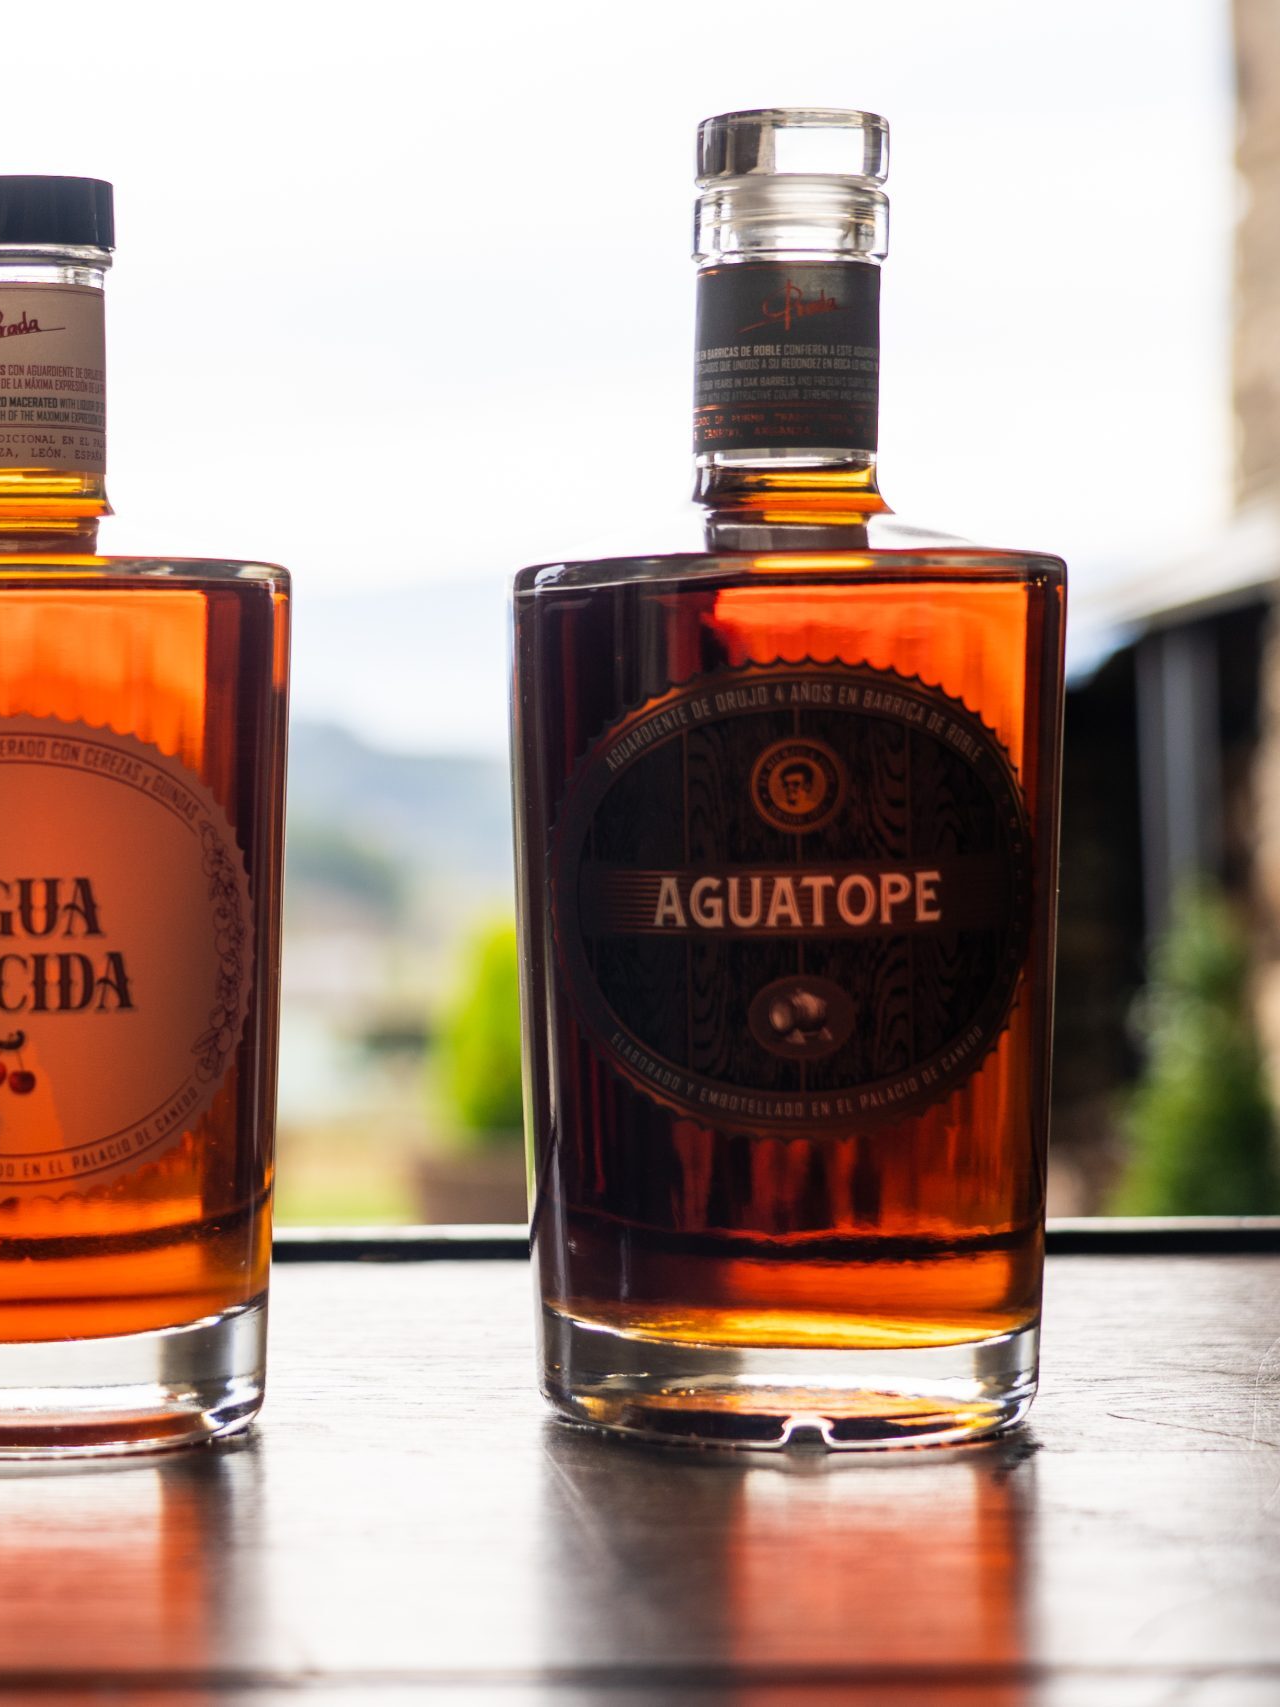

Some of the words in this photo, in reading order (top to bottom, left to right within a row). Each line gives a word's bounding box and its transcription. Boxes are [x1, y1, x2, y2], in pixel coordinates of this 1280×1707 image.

[740, 346, 753, 357] DE
[753, 344, 781, 356] ROBLE
[783, 344, 828, 356] CONFIEREN
[829, 345, 835, 356] A
[7, 364, 24, 376] CON
[26, 365, 75, 378] AGUARDIENTE
[732, 359, 760, 371] UNIDOS
[768, 358, 780, 370] SU
[781, 358, 821, 370] REDONDEZ
[822, 359, 833, 369] EN
[1, 378, 12, 390] DE
[13, 378, 23, 390] LA
[24, 377, 54, 391] MÁXIMA
[743, 376, 758, 387] OAK
[759, 375, 796, 387] BARRELS
[9, 396, 58, 409] MACERATED
[59, 398, 76, 410] WITH
[8, 410, 19, 422] OF
[19, 410, 35, 422] THE
[36, 410, 70, 422] MAXIMUM
[62, 435, 75, 446] EN
[79, 436, 90, 447] EL
[605, 707, 689, 773] AGUARDIENTE
[690, 697, 711, 720] DE
[714, 686, 770, 713] ORUJO
[790, 681, 833, 704] AÑOS
[838, 686, 859, 706] EN
[862, 690, 925, 724] BARRICA
[926, 711, 947, 735] DE
[945, 723, 983, 763] ROBLE
[51, 740, 81, 762] CON
[82, 747, 143, 781] CEREZAS
[151, 773, 199, 821] GUINDAS
[652, 869, 943, 930] AGUATOPE
[611, 1032, 682, 1091] ELABORADO
[700, 1087, 806, 1119] EMBOTELLADO
[810, 1101, 832, 1118] EN
[836, 1098, 853, 1114] EL
[859, 1077, 919, 1110] PALACIO
[921, 1066, 939, 1086] DE
[940, 1024, 983, 1072] CANEDO
[23, 1161, 41, 1178] EN
[48, 1159, 64, 1175] EL
[72, 1138, 132, 1170] PALACIO
[135, 1126, 153, 1147] DE
[154, 1086, 199, 1132] CANEDO
